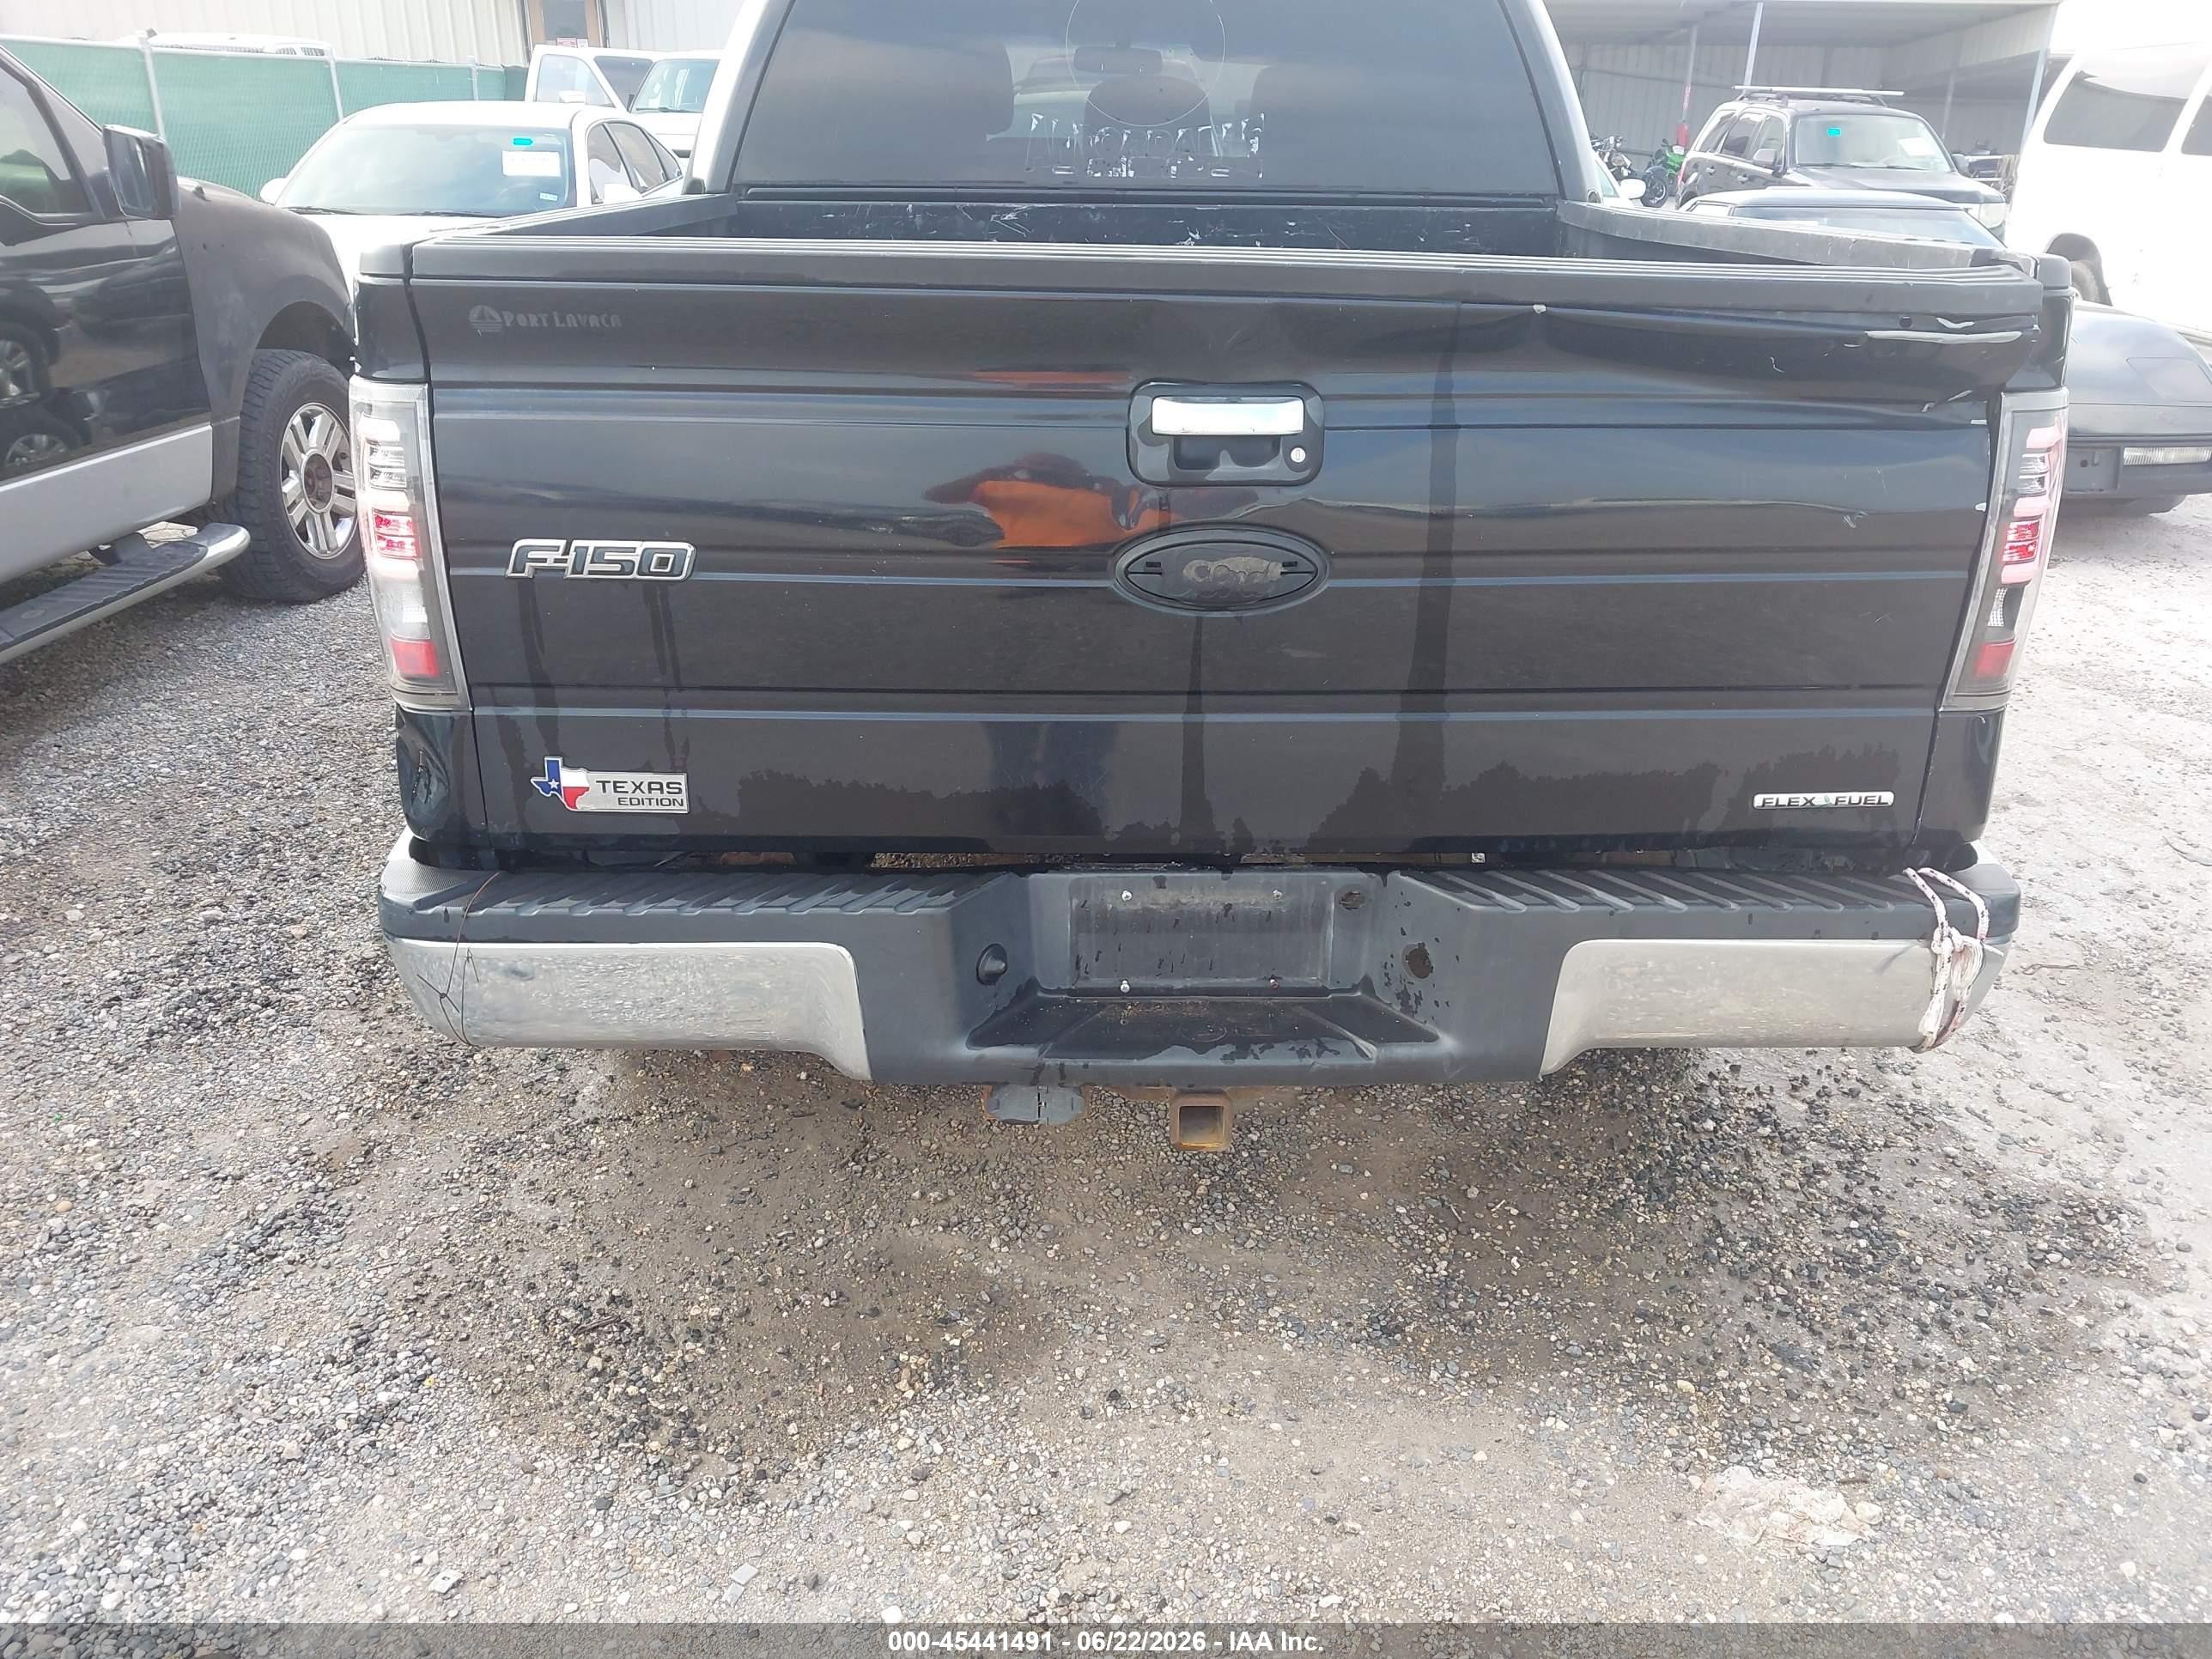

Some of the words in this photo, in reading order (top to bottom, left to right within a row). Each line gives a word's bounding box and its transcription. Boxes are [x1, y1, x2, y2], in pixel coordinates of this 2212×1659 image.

[501, 311, 550, 327] PORT
[552, 312, 623, 328] LAVACA
[505, 538, 697, 580] F-150
[596, 780, 683, 795] TEXAS
[617, 797, 684, 807] EDITION
[1761, 797, 1816, 808] FLEX
[1834, 795, 1889, 806] FUEL
